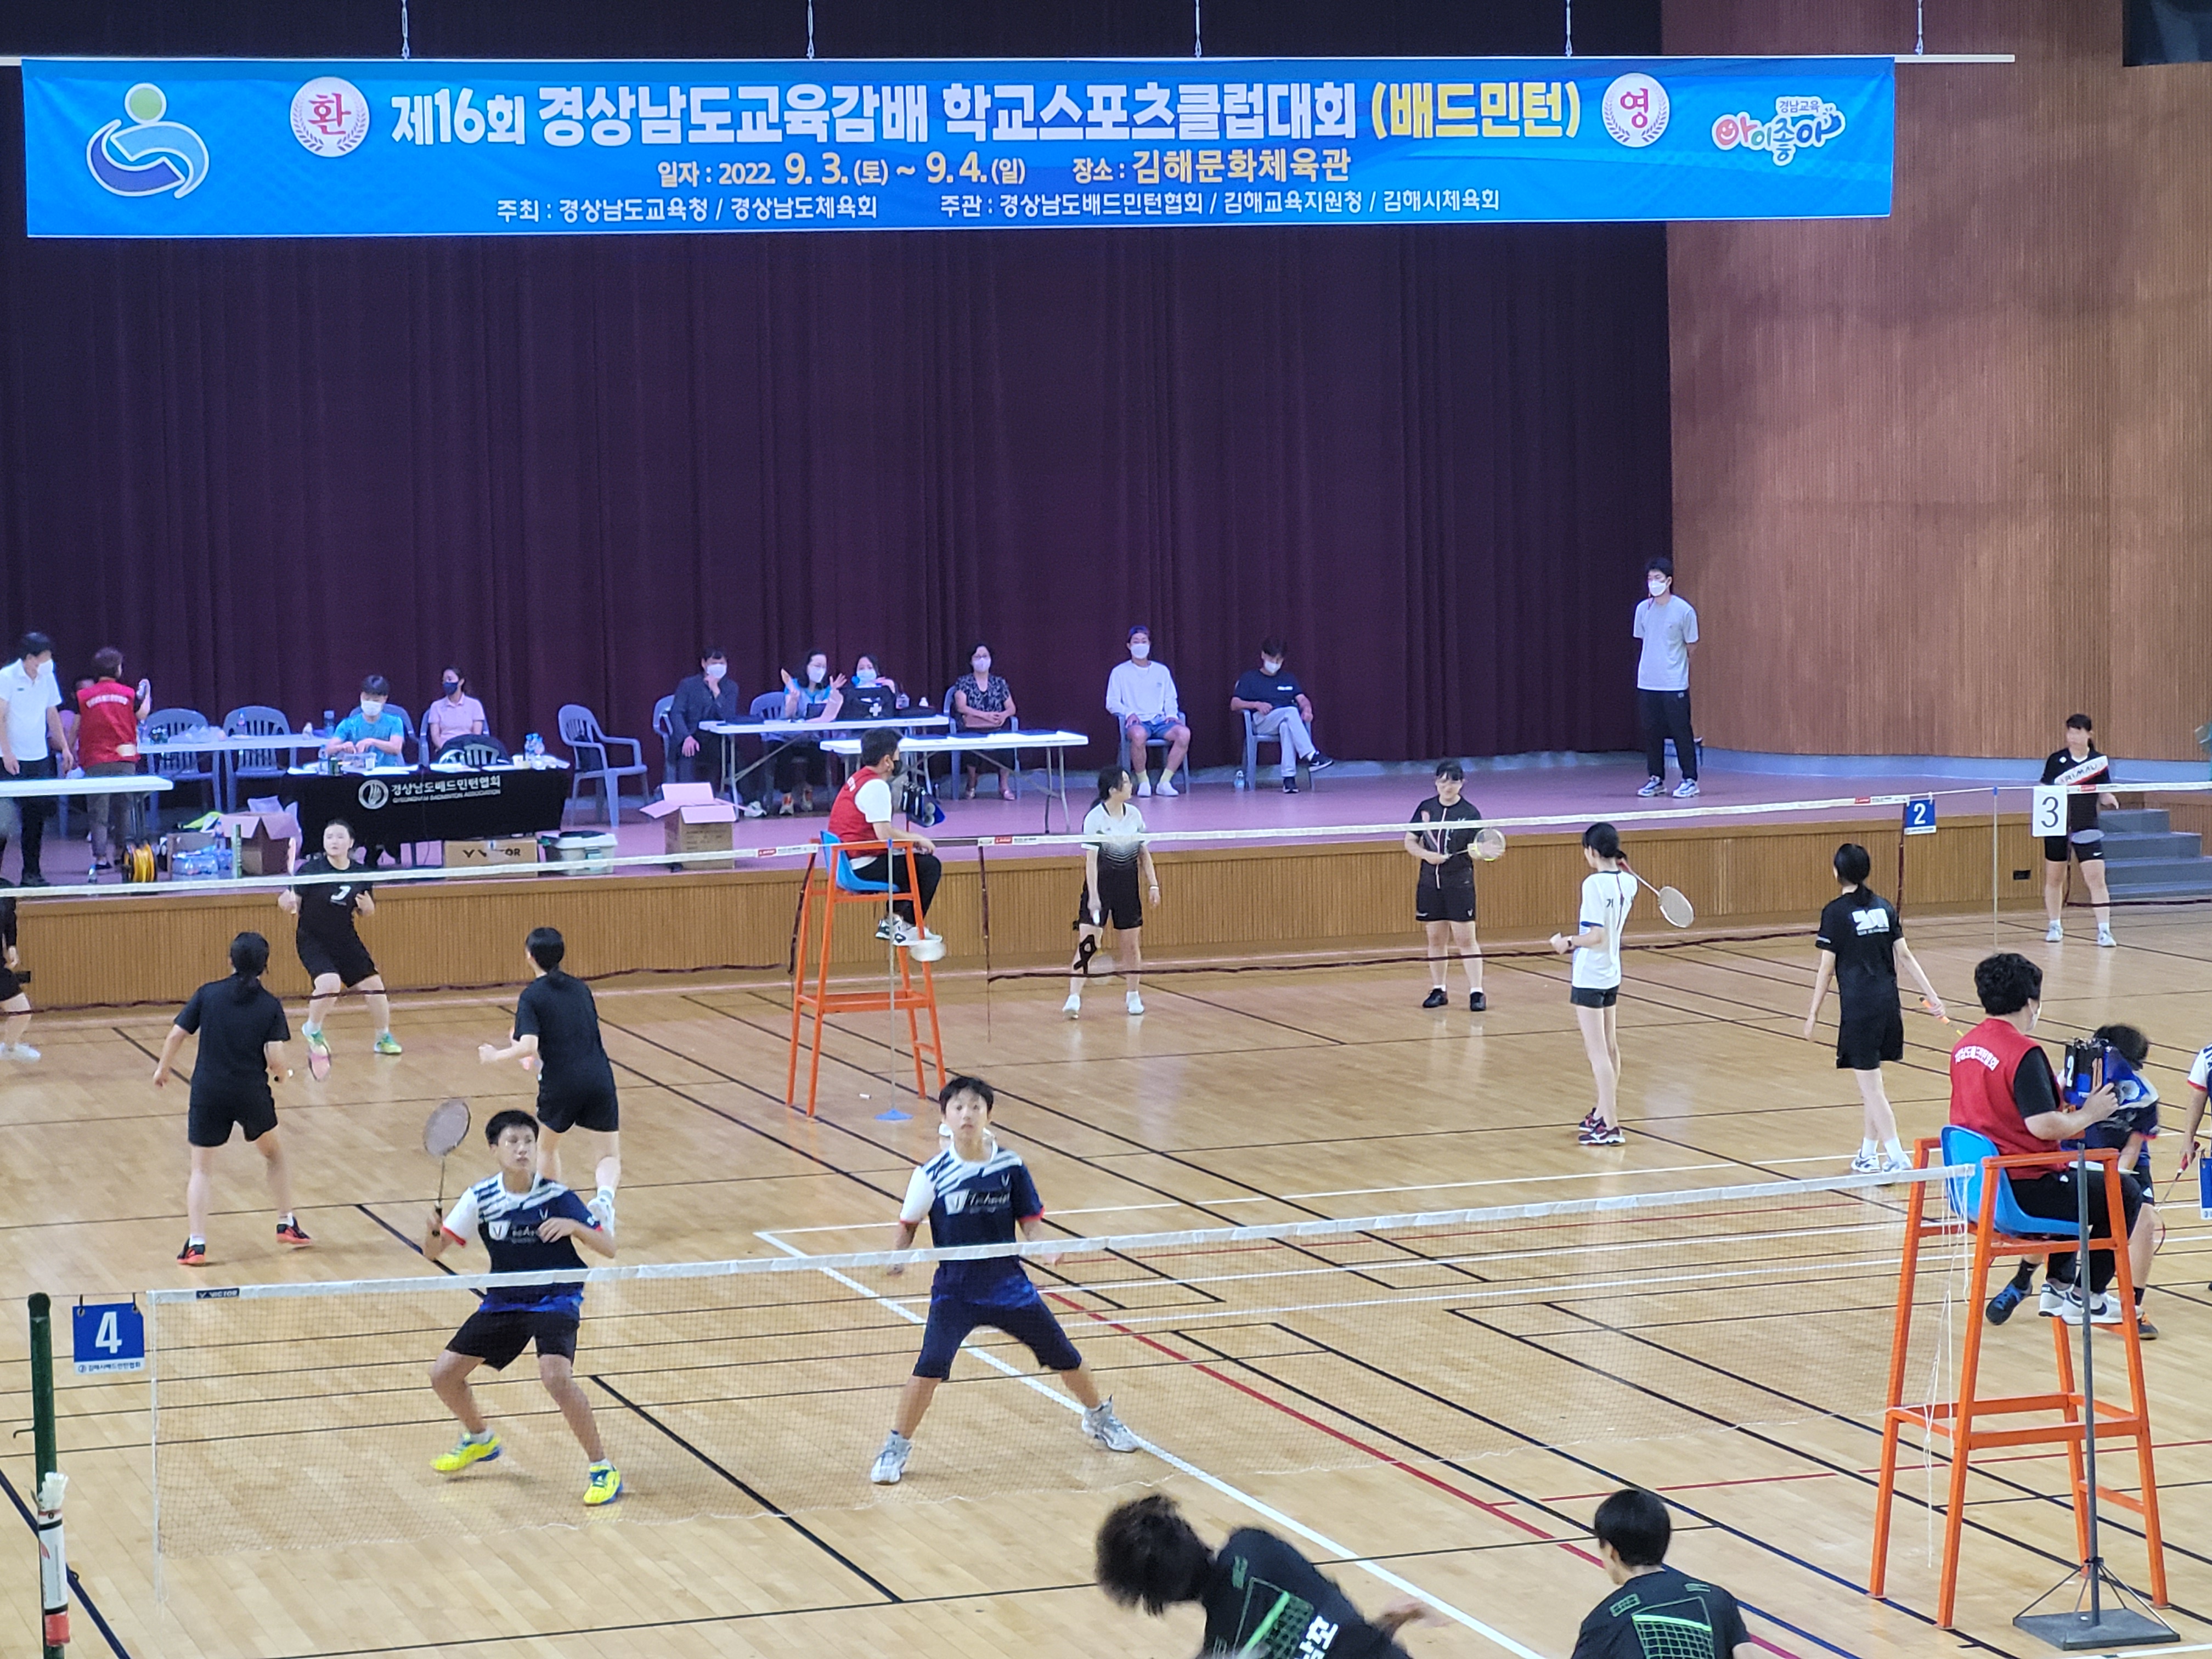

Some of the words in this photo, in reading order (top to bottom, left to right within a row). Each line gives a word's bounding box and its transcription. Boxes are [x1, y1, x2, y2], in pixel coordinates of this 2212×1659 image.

[308, 92, 352, 135] 환
[391, 88, 526, 145] 제16회
[538, 84, 929, 147] 경상남도교육감배
[943, 82, 1357, 142] 학교스포츠클럽대회
[1372, 81, 1581, 140] (배드민턴)
[1620, 88, 1649, 128] 영
[1779, 100, 1820, 113] 경남교육
[1716, 114, 1842, 161] 아이좋아
[1132, 148, 1352, 184] 김해문화체육관
[560, 198, 709, 223] 경상남도교육청
[731, 195, 877, 221] 경상남도체육회
[1000, 192, 1203, 218] 경상남도배드민턴협회
[1224, 191, 1362, 215] 김해교육지원청
[1384, 189, 1500, 212] 김해시체육회
[391, 775, 500, 795] 경상남도배드민턴협회
[1914, 803, 1926, 825] 2
[2041, 796, 2058, 827] 3
[208, 1290, 238, 1298] VICTOR
[95, 1311, 122, 1354] 4
